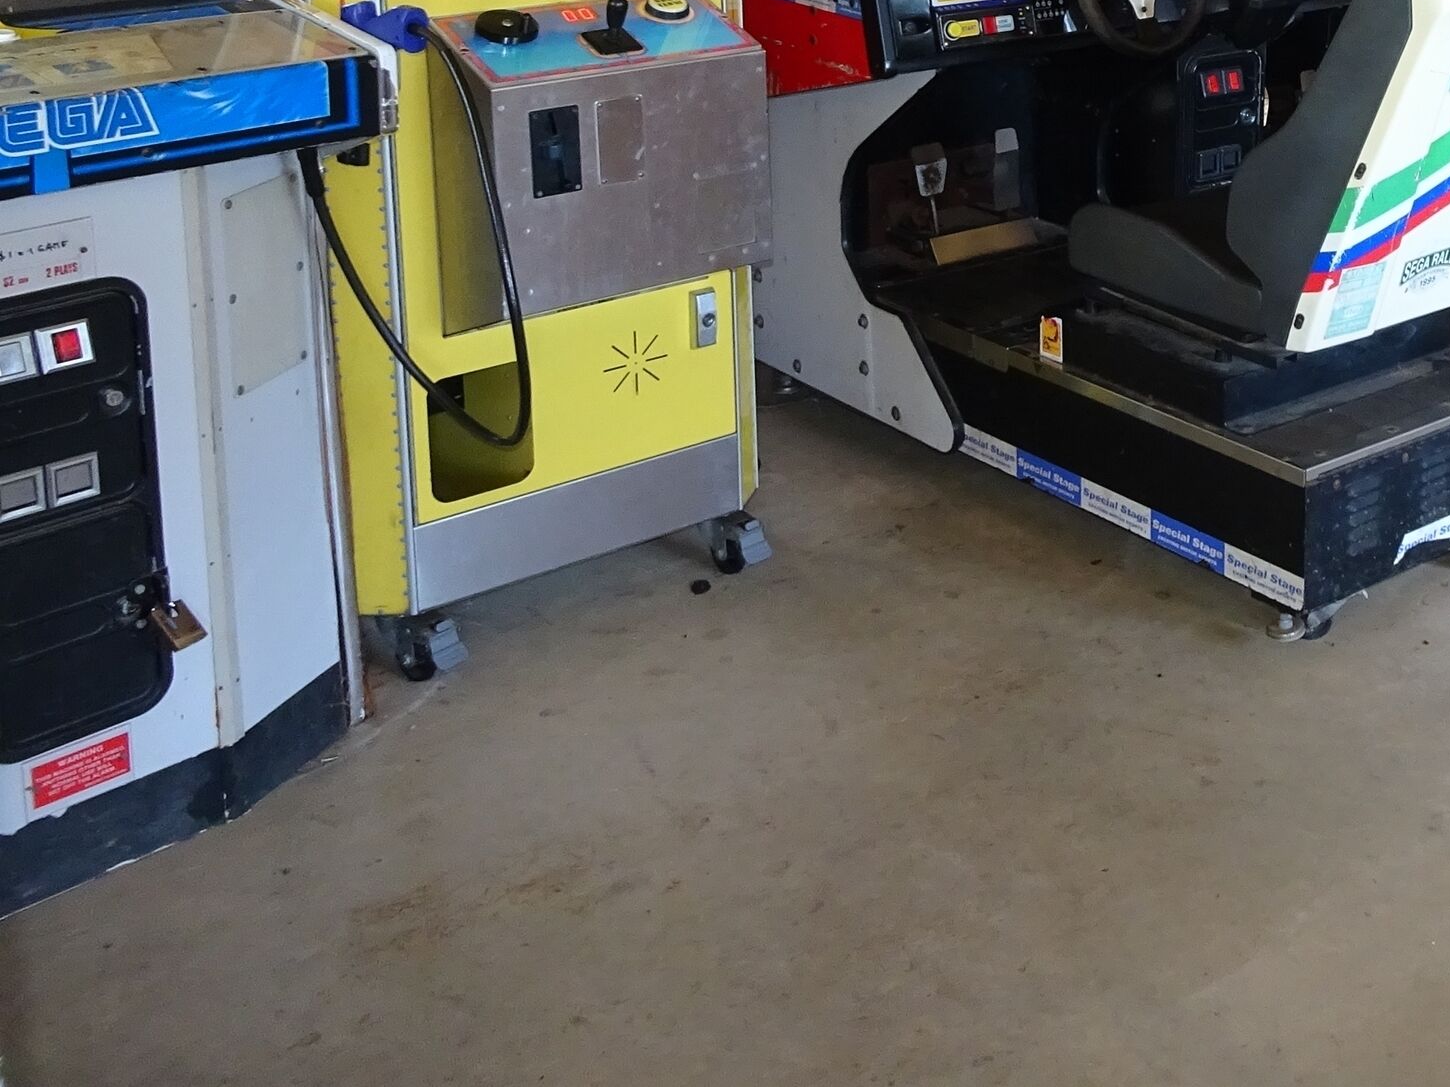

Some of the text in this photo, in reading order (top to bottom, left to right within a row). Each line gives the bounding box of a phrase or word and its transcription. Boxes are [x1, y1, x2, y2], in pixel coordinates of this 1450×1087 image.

[0, 87, 160, 158] EGA
[1402, 255, 1431, 283] SEGA
[991, 443, 1015, 462] Stage
[1017, 457, 1080, 493] Special Stage
[1083, 487, 1119, 510] Special
[1120, 504, 1149, 525] Stage
[1152, 518, 1223, 560] Special Stage
[1227, 553, 1267, 580] Special
[1269, 573, 1303, 596] Stage
